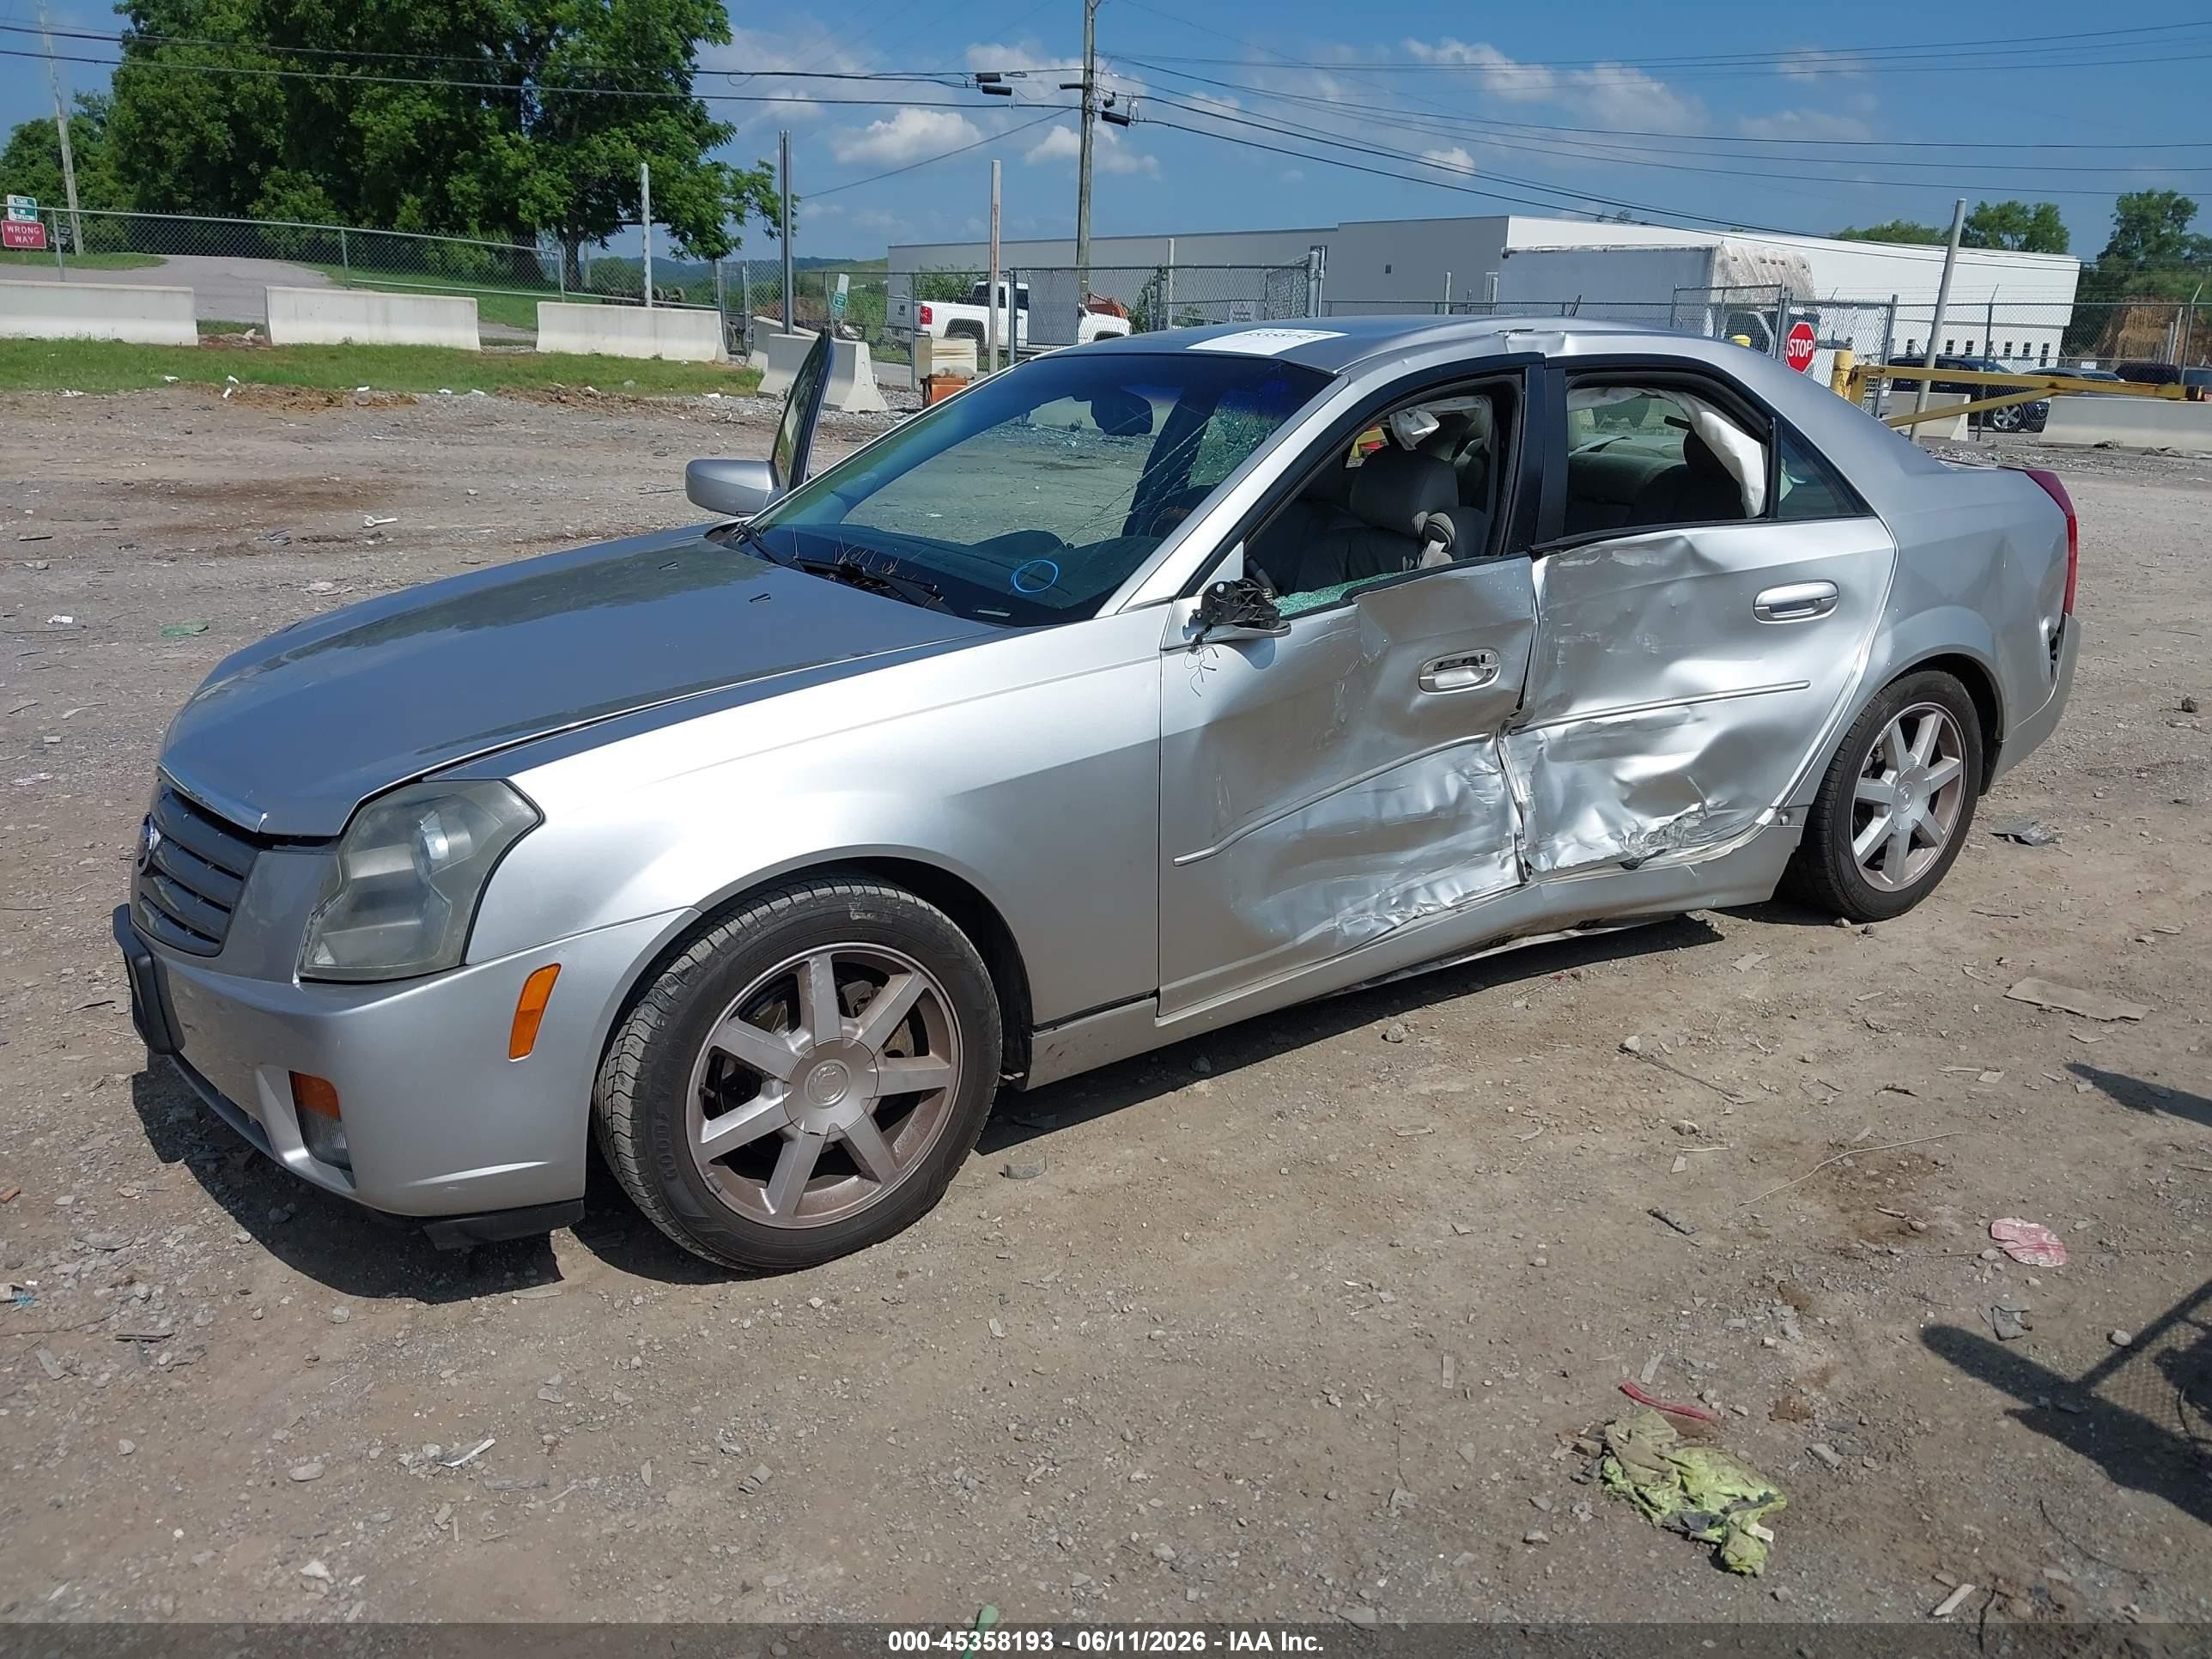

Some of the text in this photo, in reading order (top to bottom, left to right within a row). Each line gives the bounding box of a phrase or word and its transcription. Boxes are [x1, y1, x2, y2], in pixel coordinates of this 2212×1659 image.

[7, 225, 40, 234] WRONG
[14, 235, 34, 244] WAY
[1788, 338, 1814, 358] STOP
